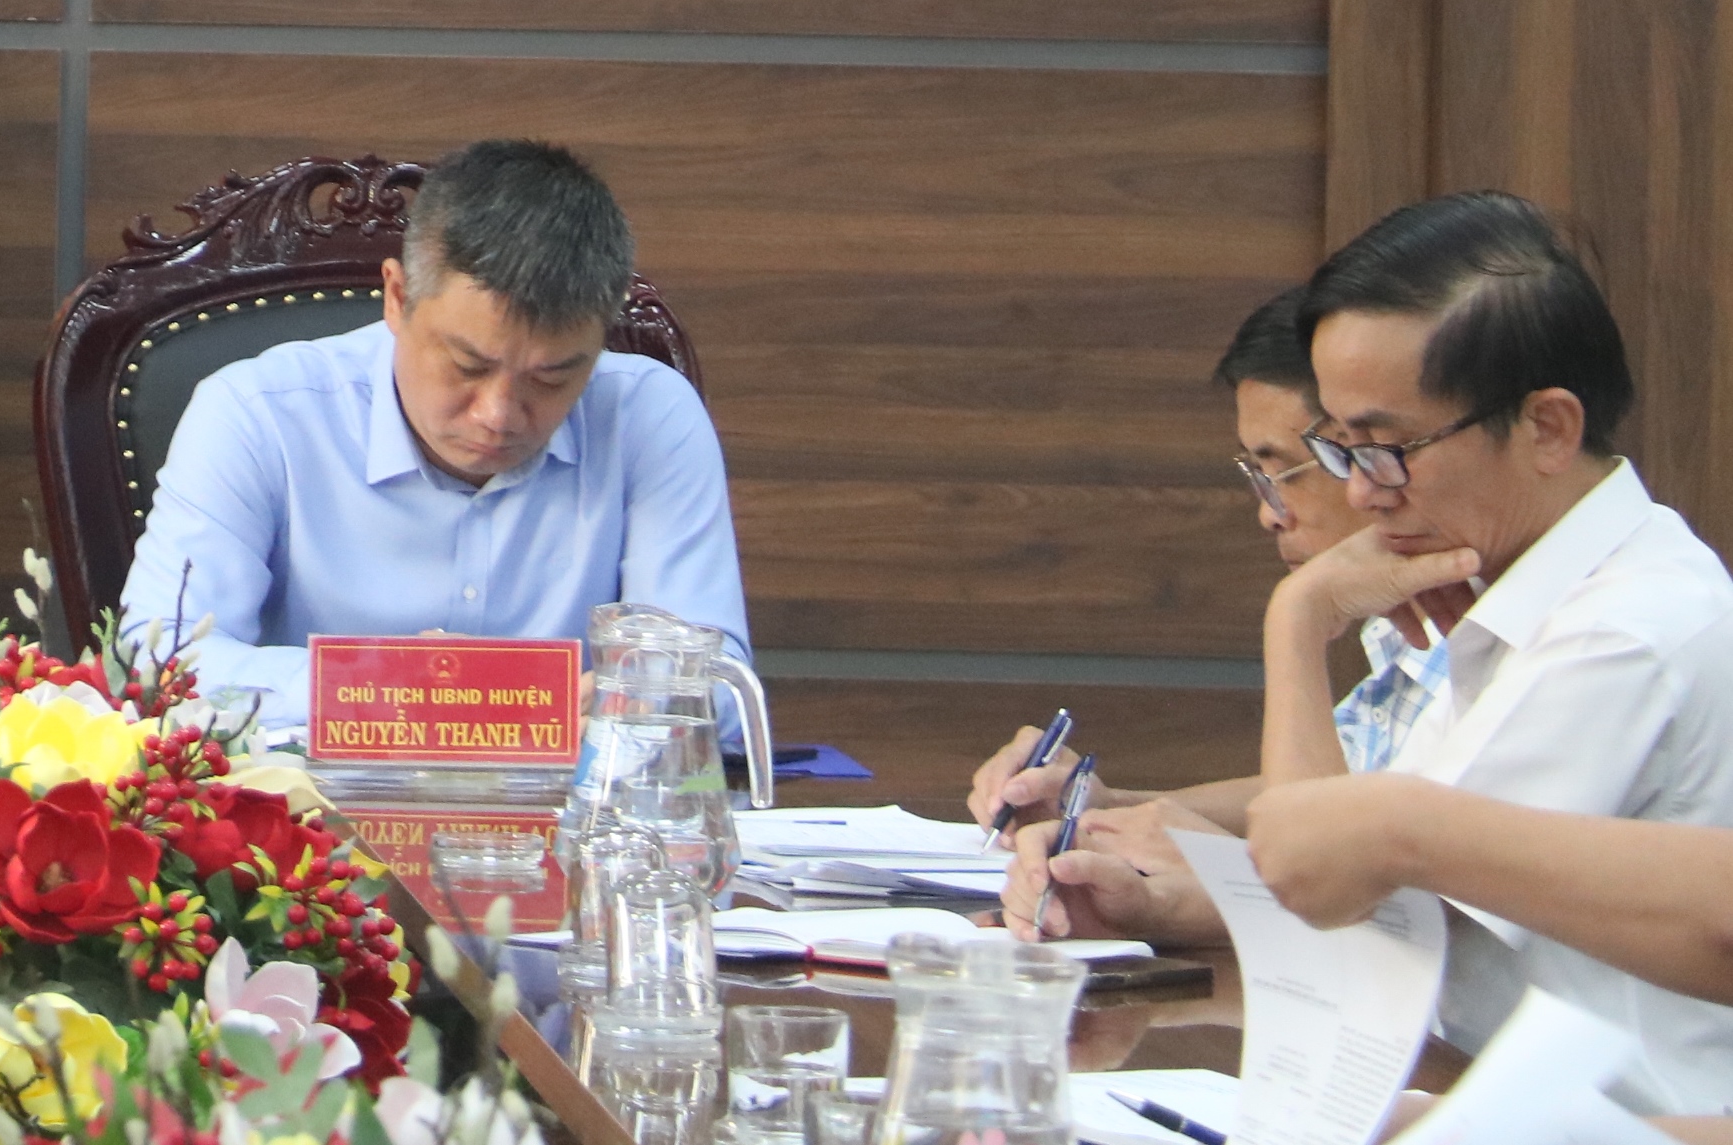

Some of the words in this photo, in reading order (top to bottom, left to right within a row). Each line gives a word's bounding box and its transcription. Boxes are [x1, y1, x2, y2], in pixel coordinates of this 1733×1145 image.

[337, 681, 375, 704] CHỦ
[382, 687, 425, 708] TỊCH
[431, 688, 482, 705] UBND
[489, 685, 553, 709] HUYỆN
[325, 709, 427, 746] NGUYỄN
[434, 722, 522, 747] THANH
[528, 717, 563, 748] VŨ
